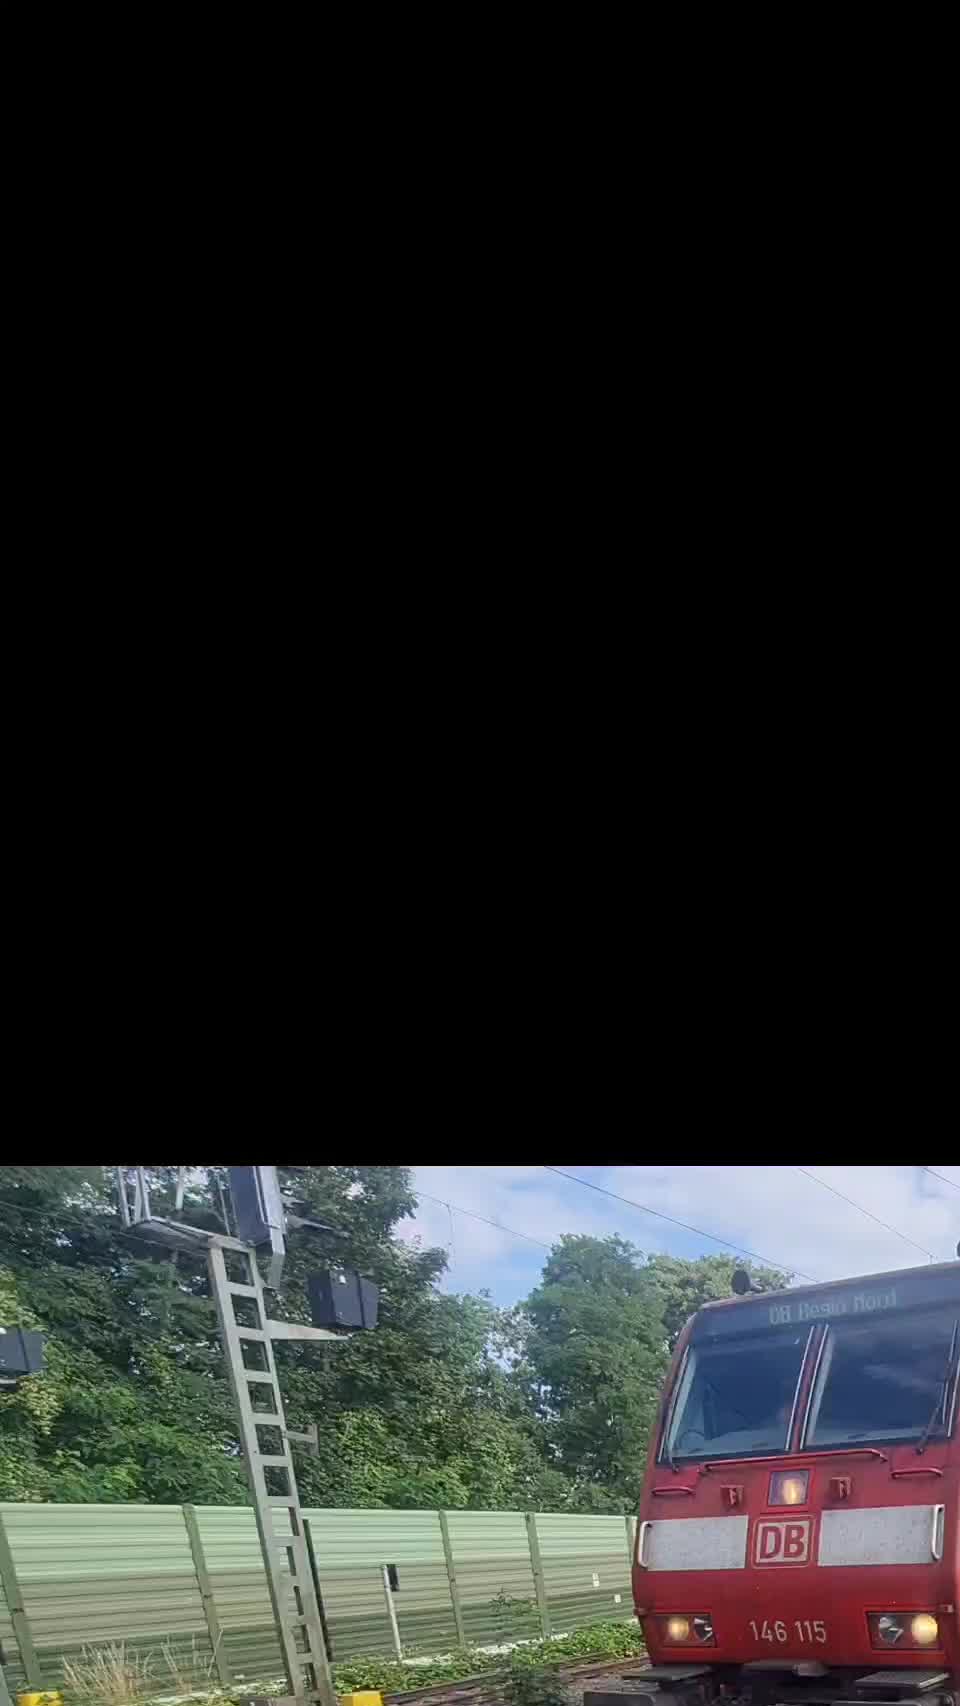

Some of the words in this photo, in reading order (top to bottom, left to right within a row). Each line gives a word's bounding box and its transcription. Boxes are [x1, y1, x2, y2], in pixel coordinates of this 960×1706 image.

[759, 1524, 806, 1559] DB
[749, 1620, 788, 1642] 146
[794, 1620, 828, 1643] 115
